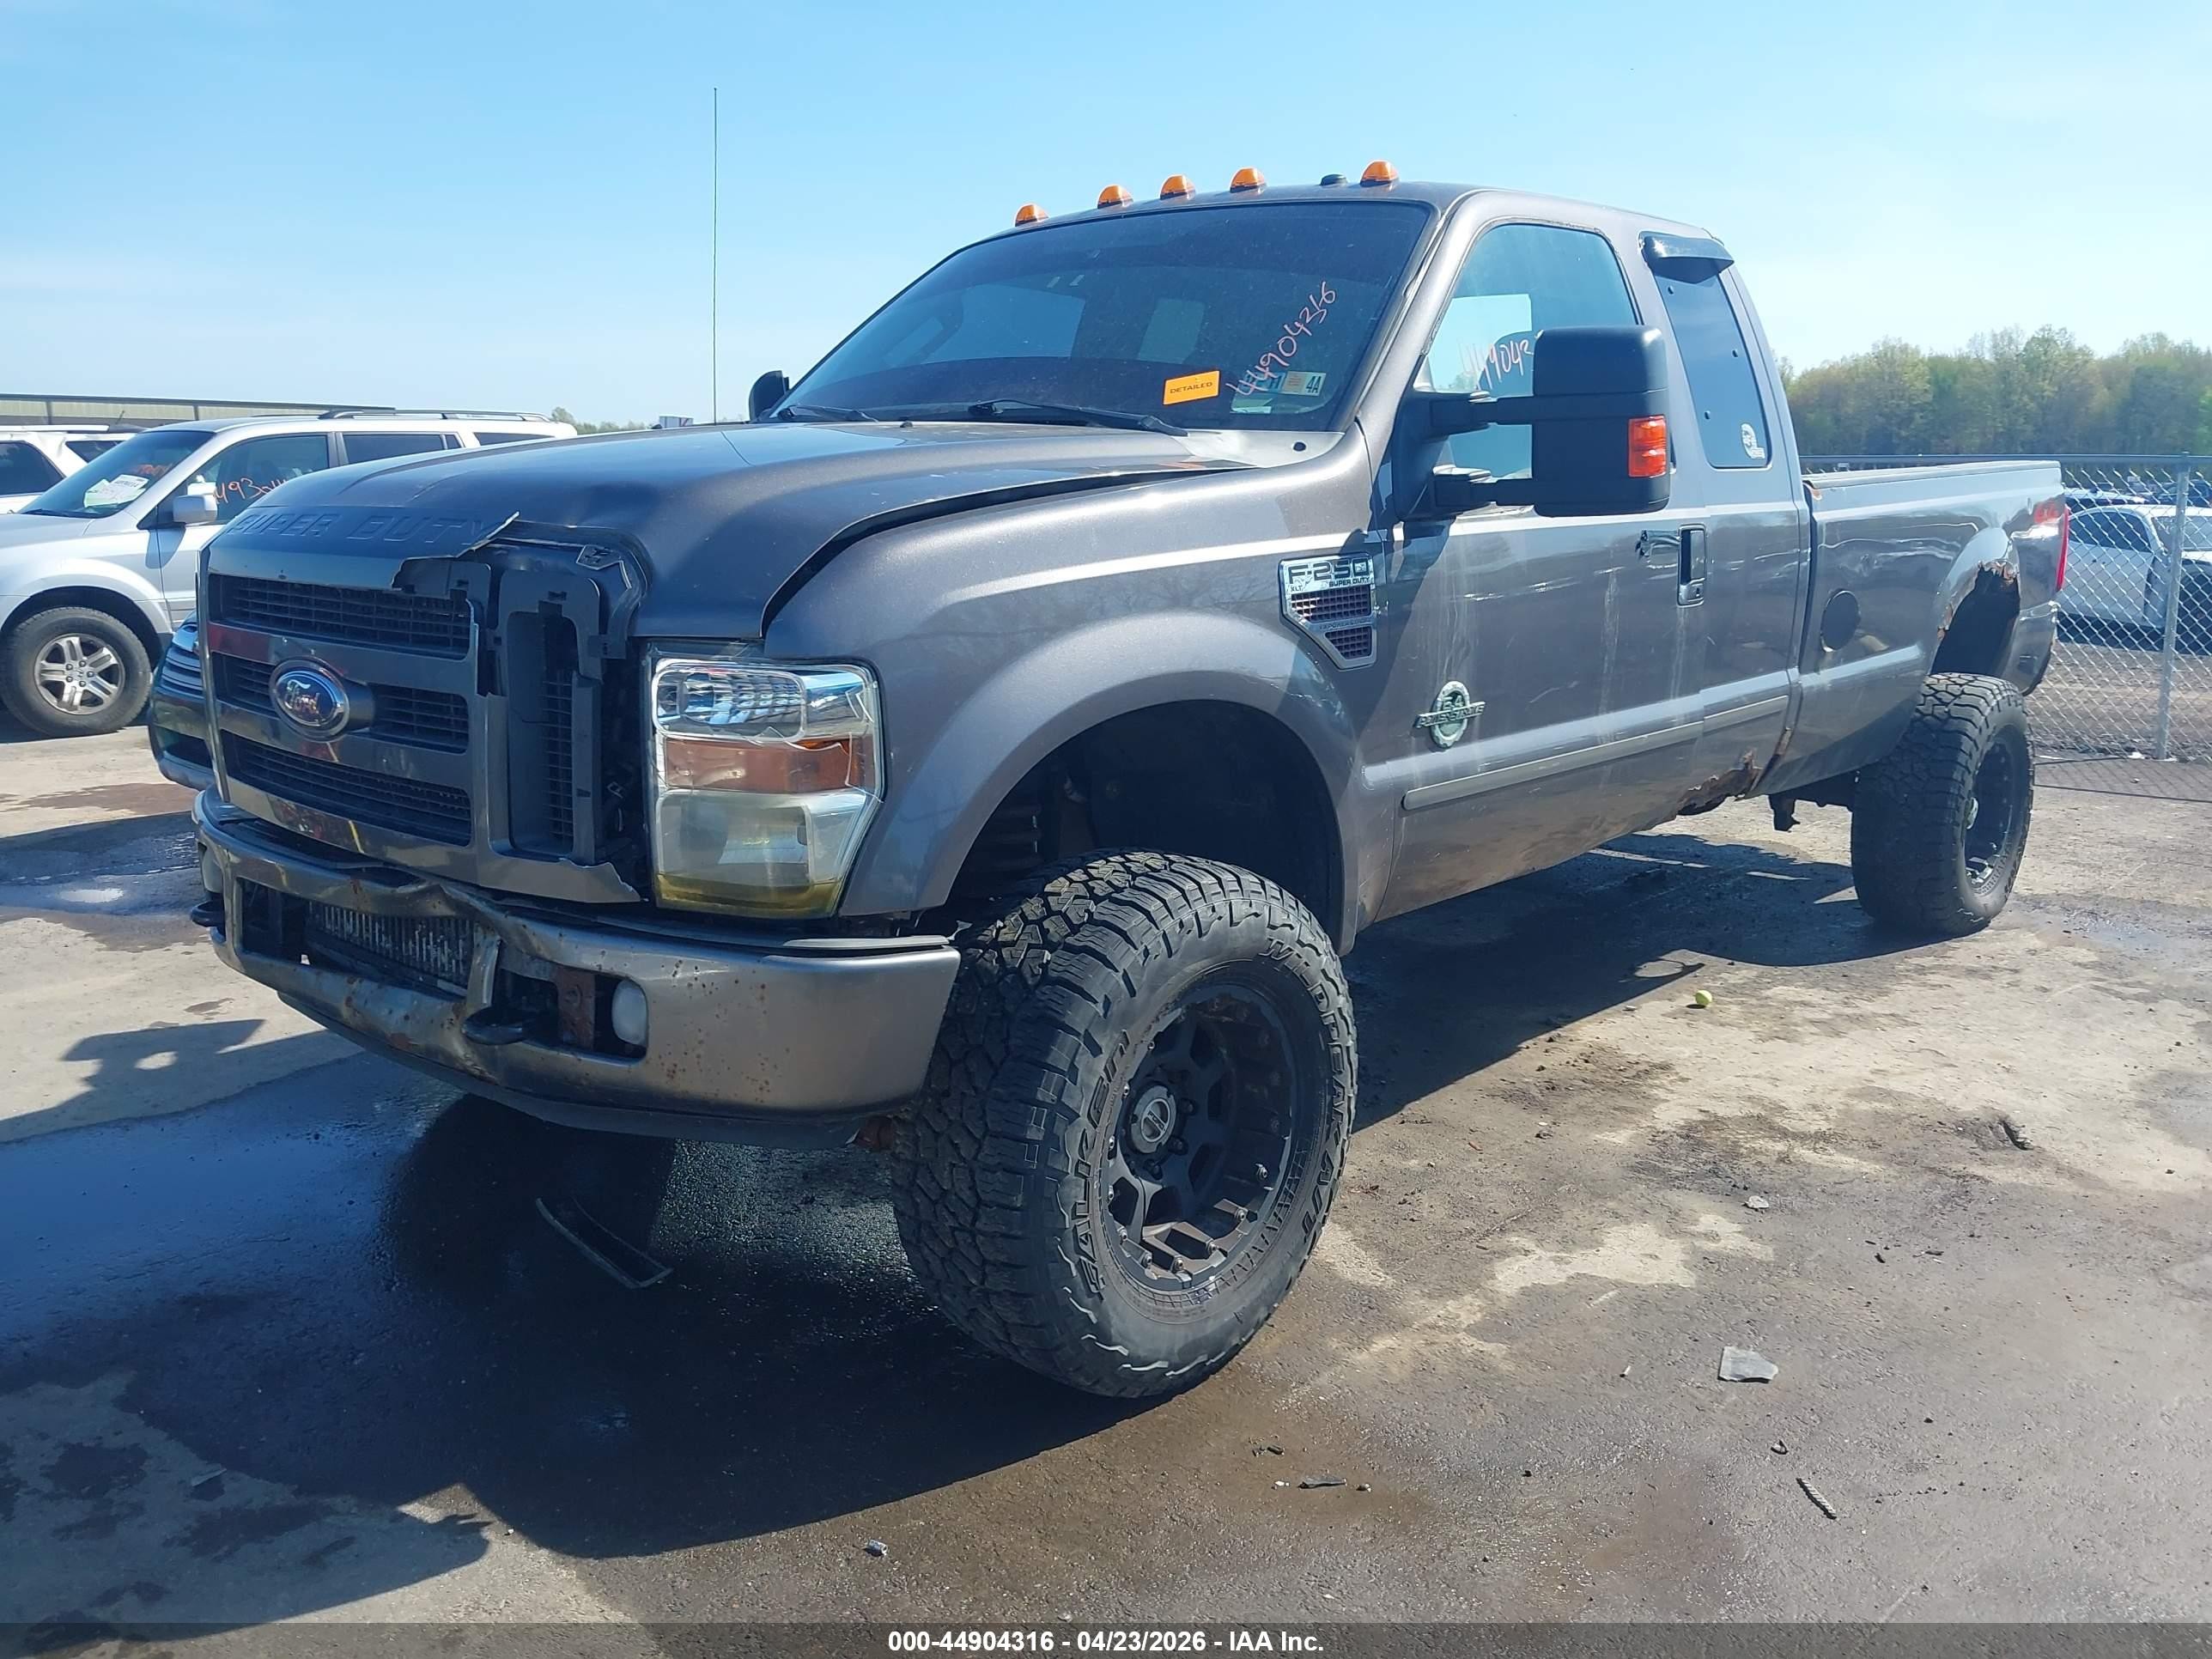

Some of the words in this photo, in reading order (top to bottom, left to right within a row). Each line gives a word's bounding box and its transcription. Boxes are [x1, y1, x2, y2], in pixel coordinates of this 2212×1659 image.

[1170, 381, 1213, 394] DETAILED
[1328, 579, 1352, 588] SUPER
[1352, 576, 1370, 586] DUTY
